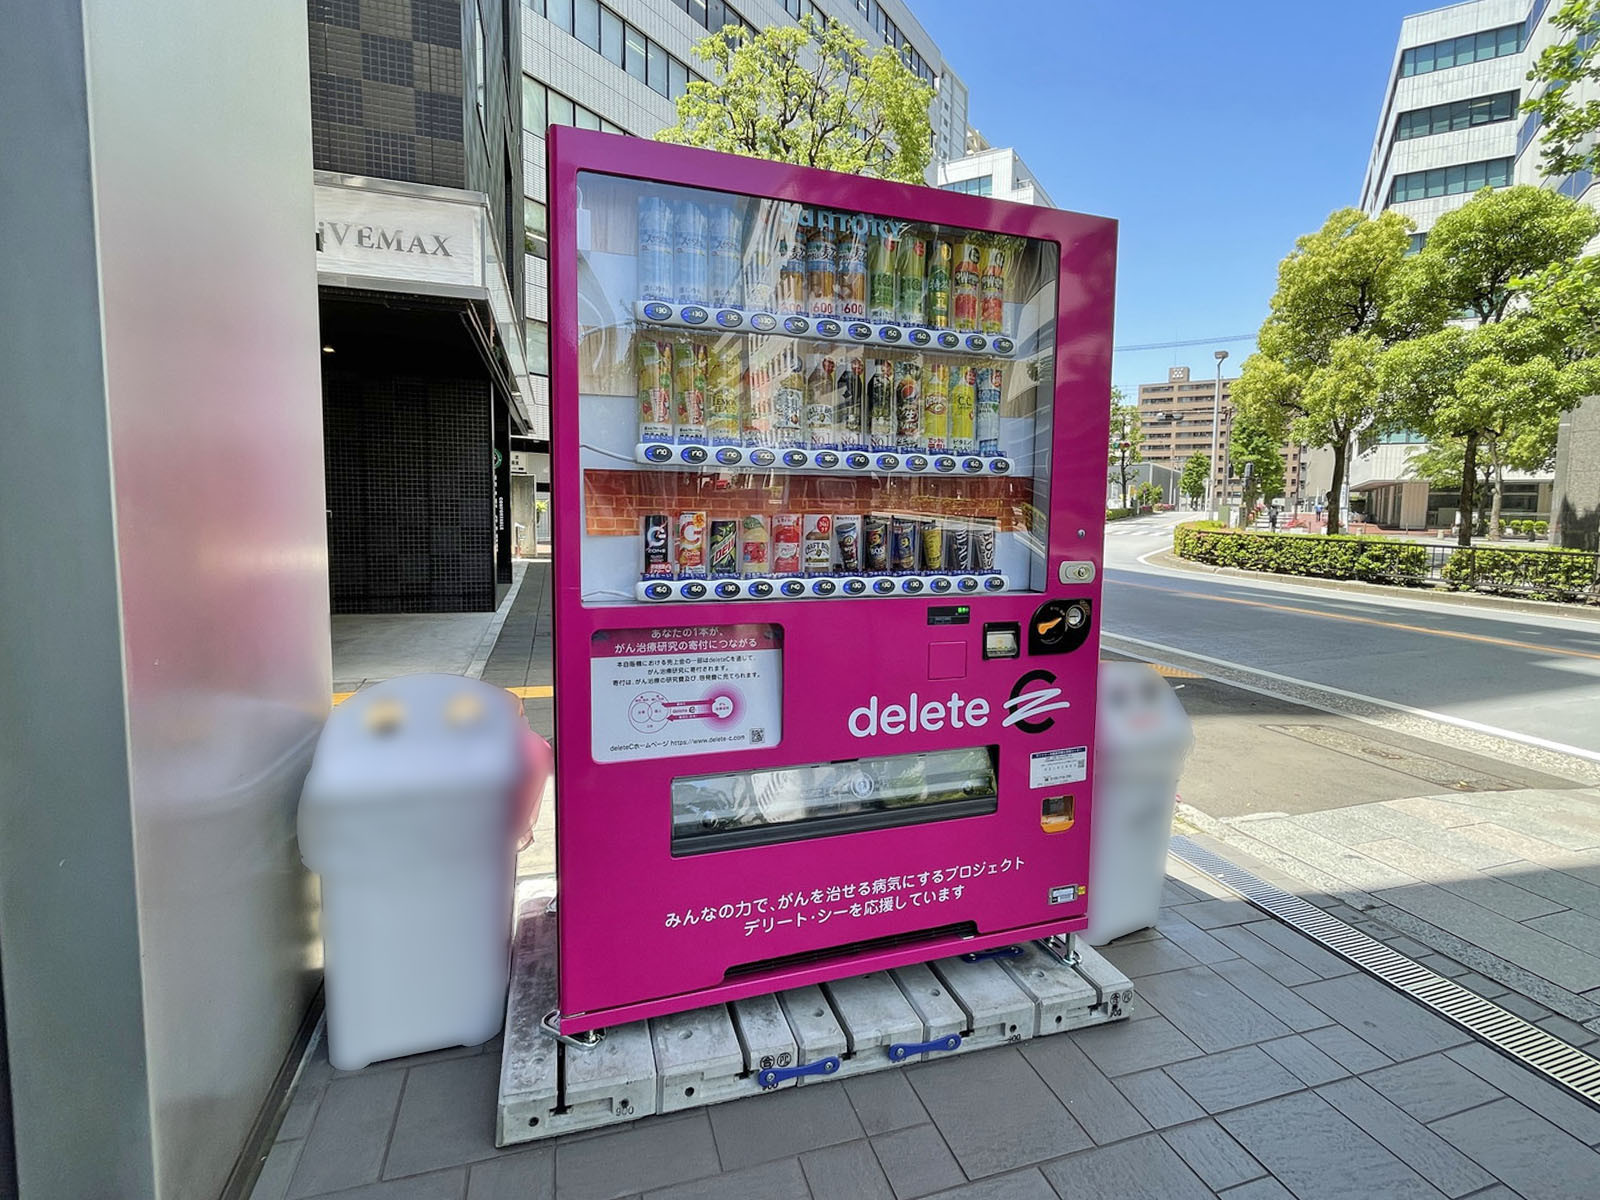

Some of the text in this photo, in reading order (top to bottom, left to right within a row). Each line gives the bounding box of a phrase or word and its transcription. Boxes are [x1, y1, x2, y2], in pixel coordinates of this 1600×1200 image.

[813, 302, 833, 313] 600
[843, 303, 863, 314] 600
[614, 638, 758, 654] がん治療研究の寄付につながる
[848, 692, 990, 738] delete
[664, 856, 1026, 928] みんなの力で、がんを治せる病気にするプロジェクト
